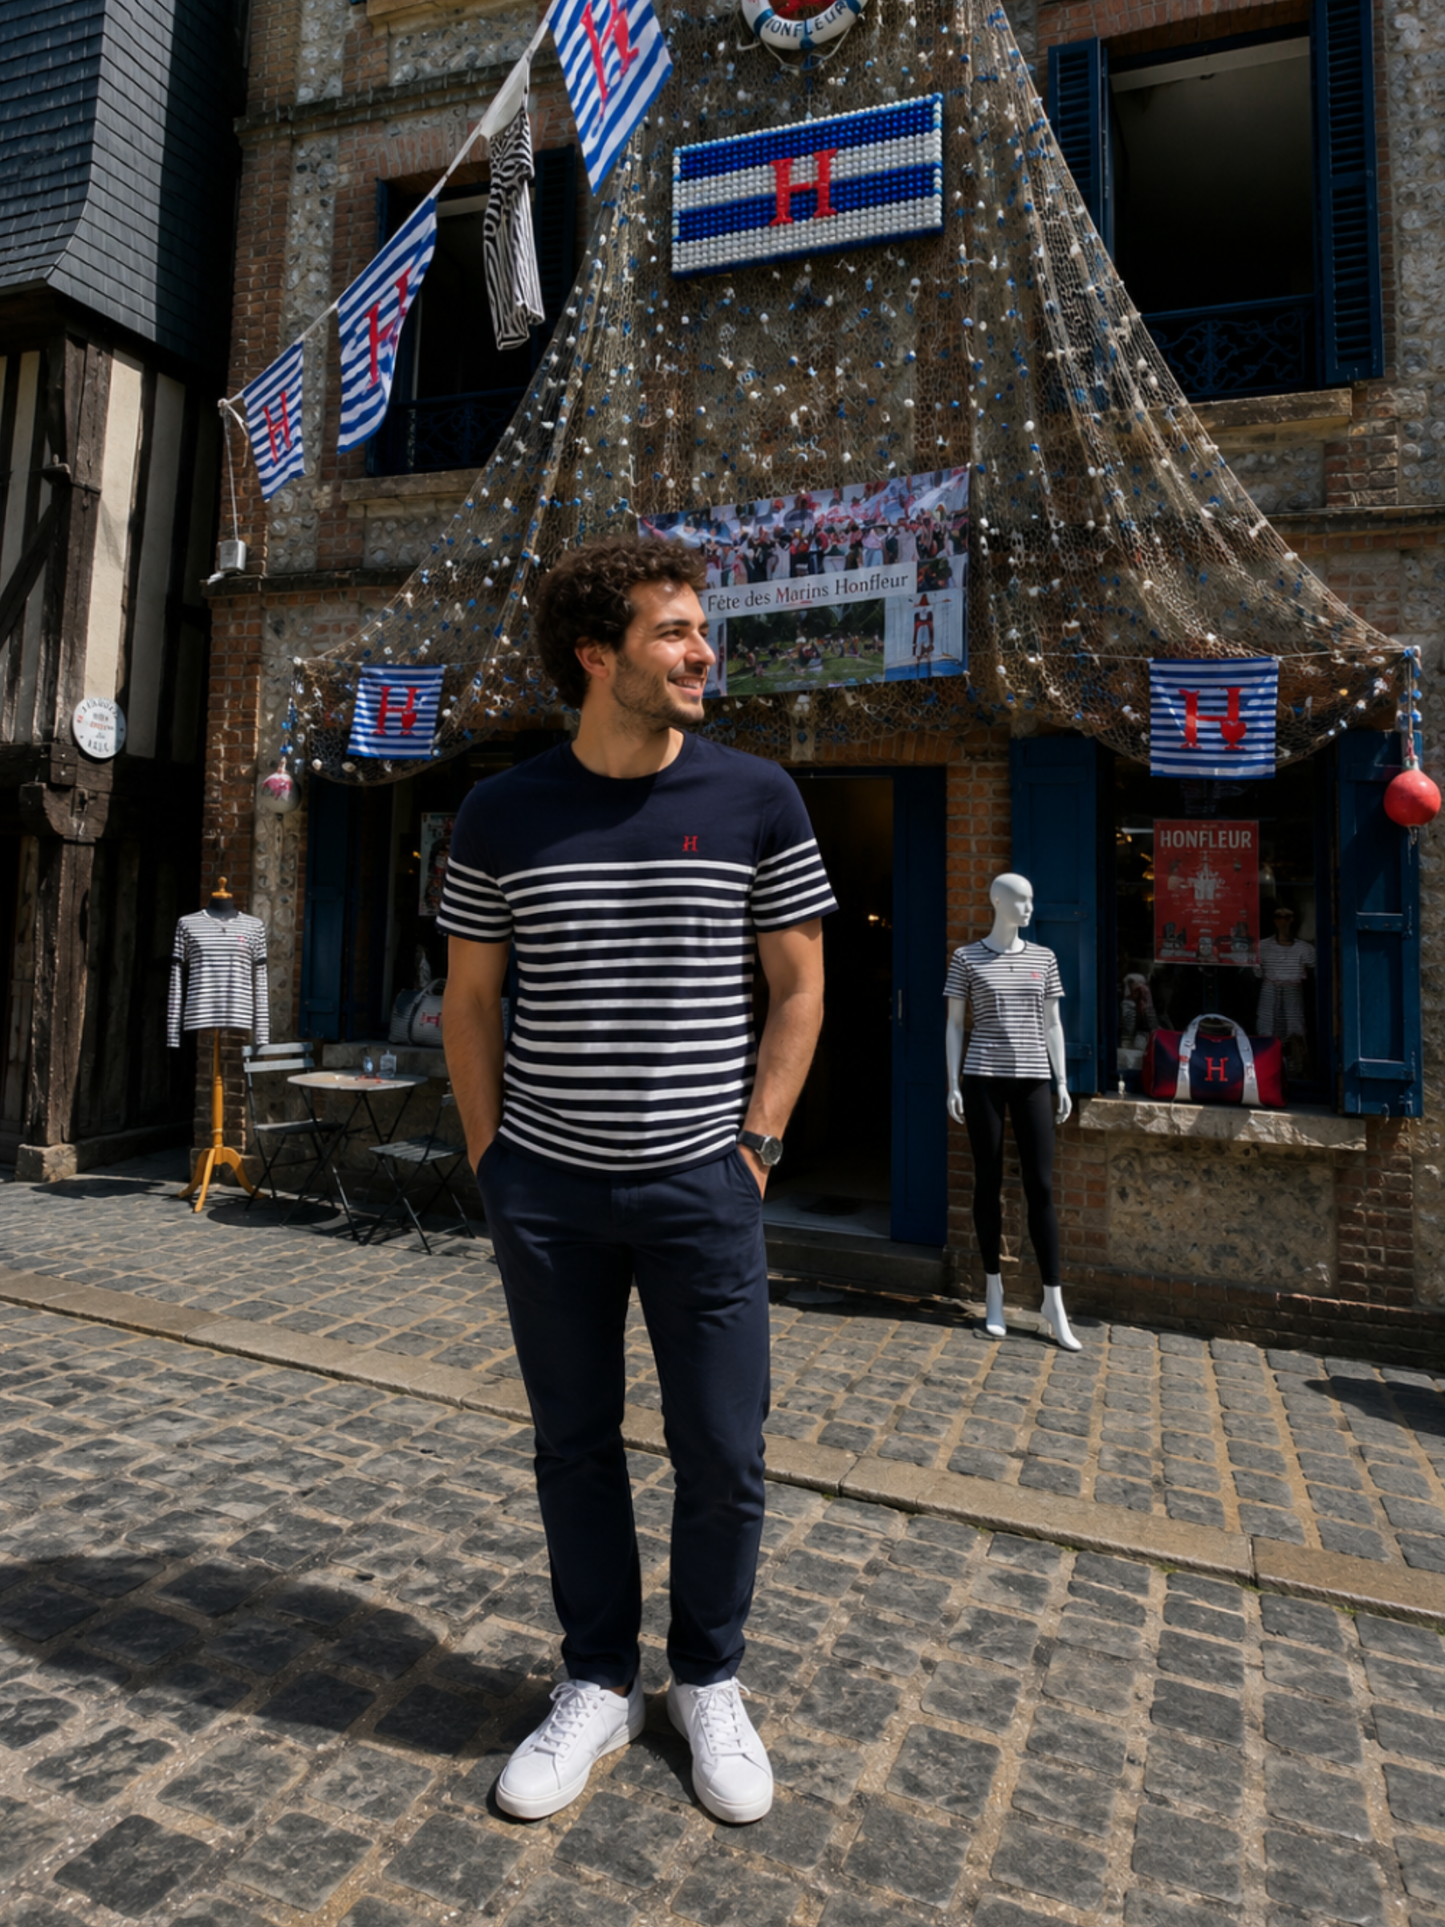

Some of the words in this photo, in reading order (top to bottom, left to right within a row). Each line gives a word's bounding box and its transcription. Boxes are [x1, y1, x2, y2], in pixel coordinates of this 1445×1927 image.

[770, 148, 838, 226] H
[263, 391, 292, 464] H
[707, 594, 740, 612] Fête
[744, 589, 771, 607] des
[775, 583, 829, 604] Marins
[835, 572, 909, 596] Honfleur
[371, 686, 421, 736] H
[1178, 687, 1247, 750] H
[683, 835, 699, 852] H
[1160, 830, 1252, 848] HONFLEUR
[1204, 1057, 1228, 1081] H
